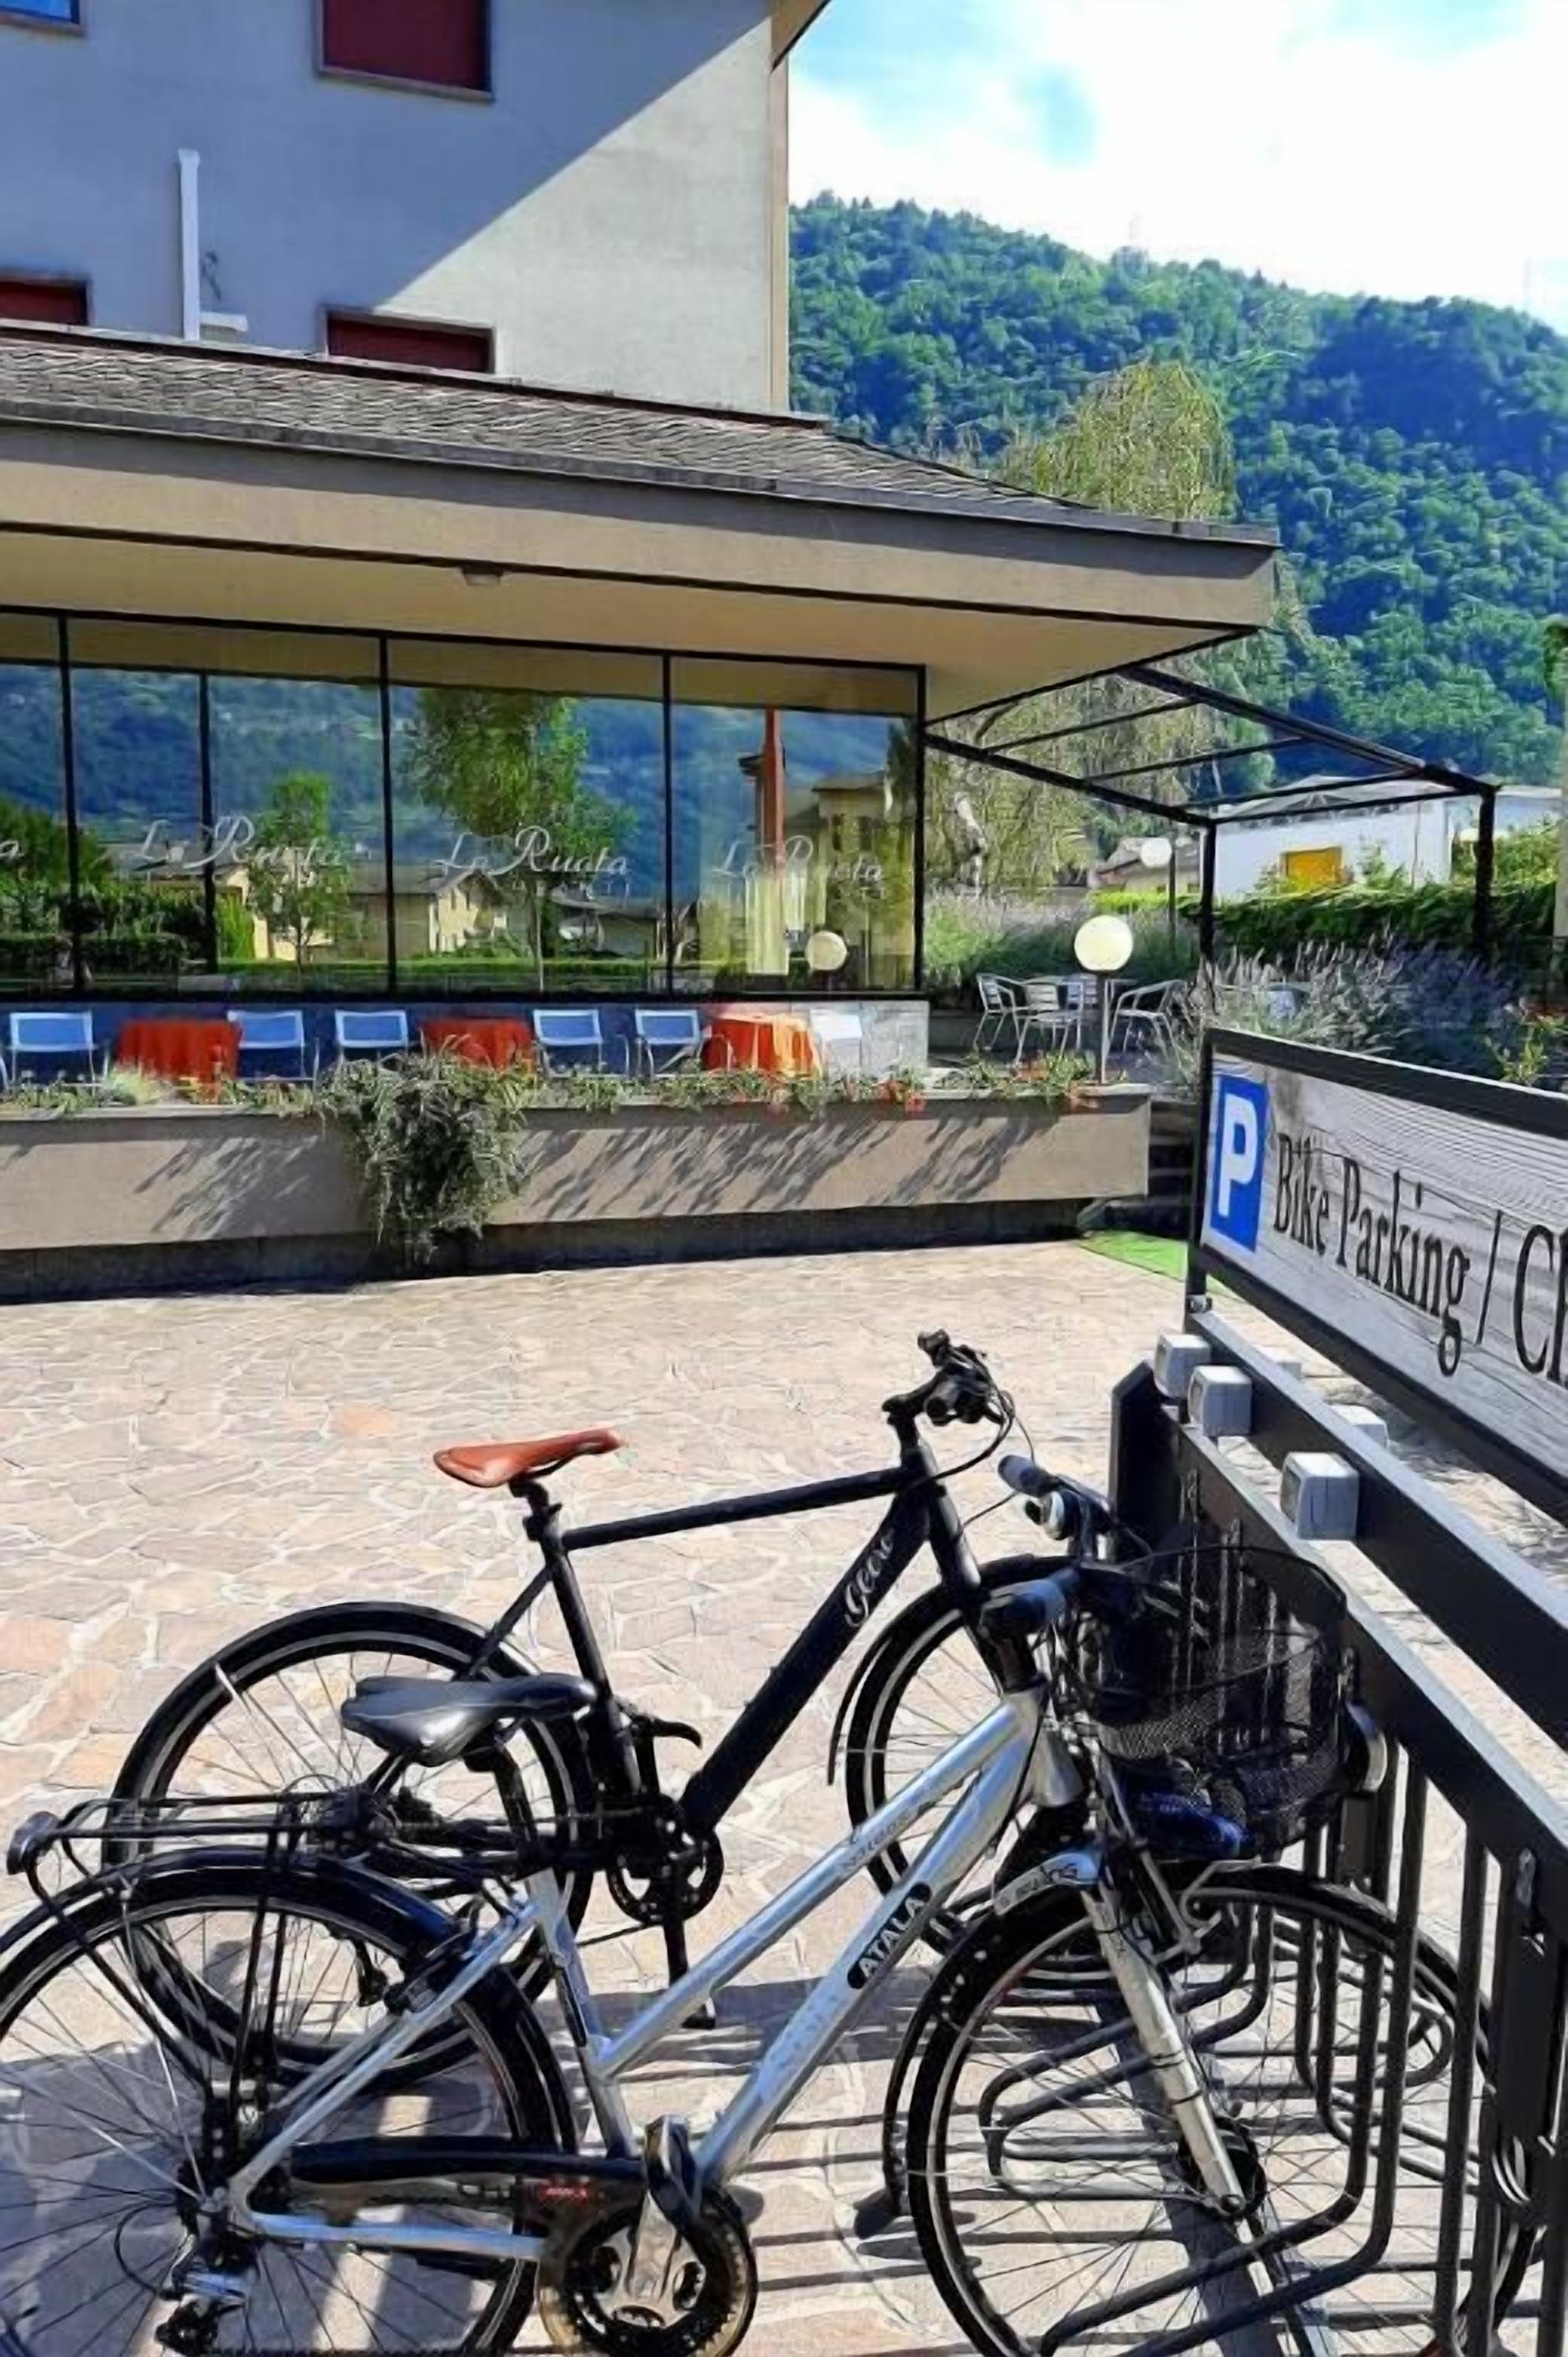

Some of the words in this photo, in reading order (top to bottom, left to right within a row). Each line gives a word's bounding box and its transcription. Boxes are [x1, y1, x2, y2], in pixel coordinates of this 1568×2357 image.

[1217, 1093, 1259, 1218] P
[1273, 1132, 1329, 1256] Bike
[1336, 1156, 1471, 1377] Parking
[858, 1897, 924, 1979] ATALA
